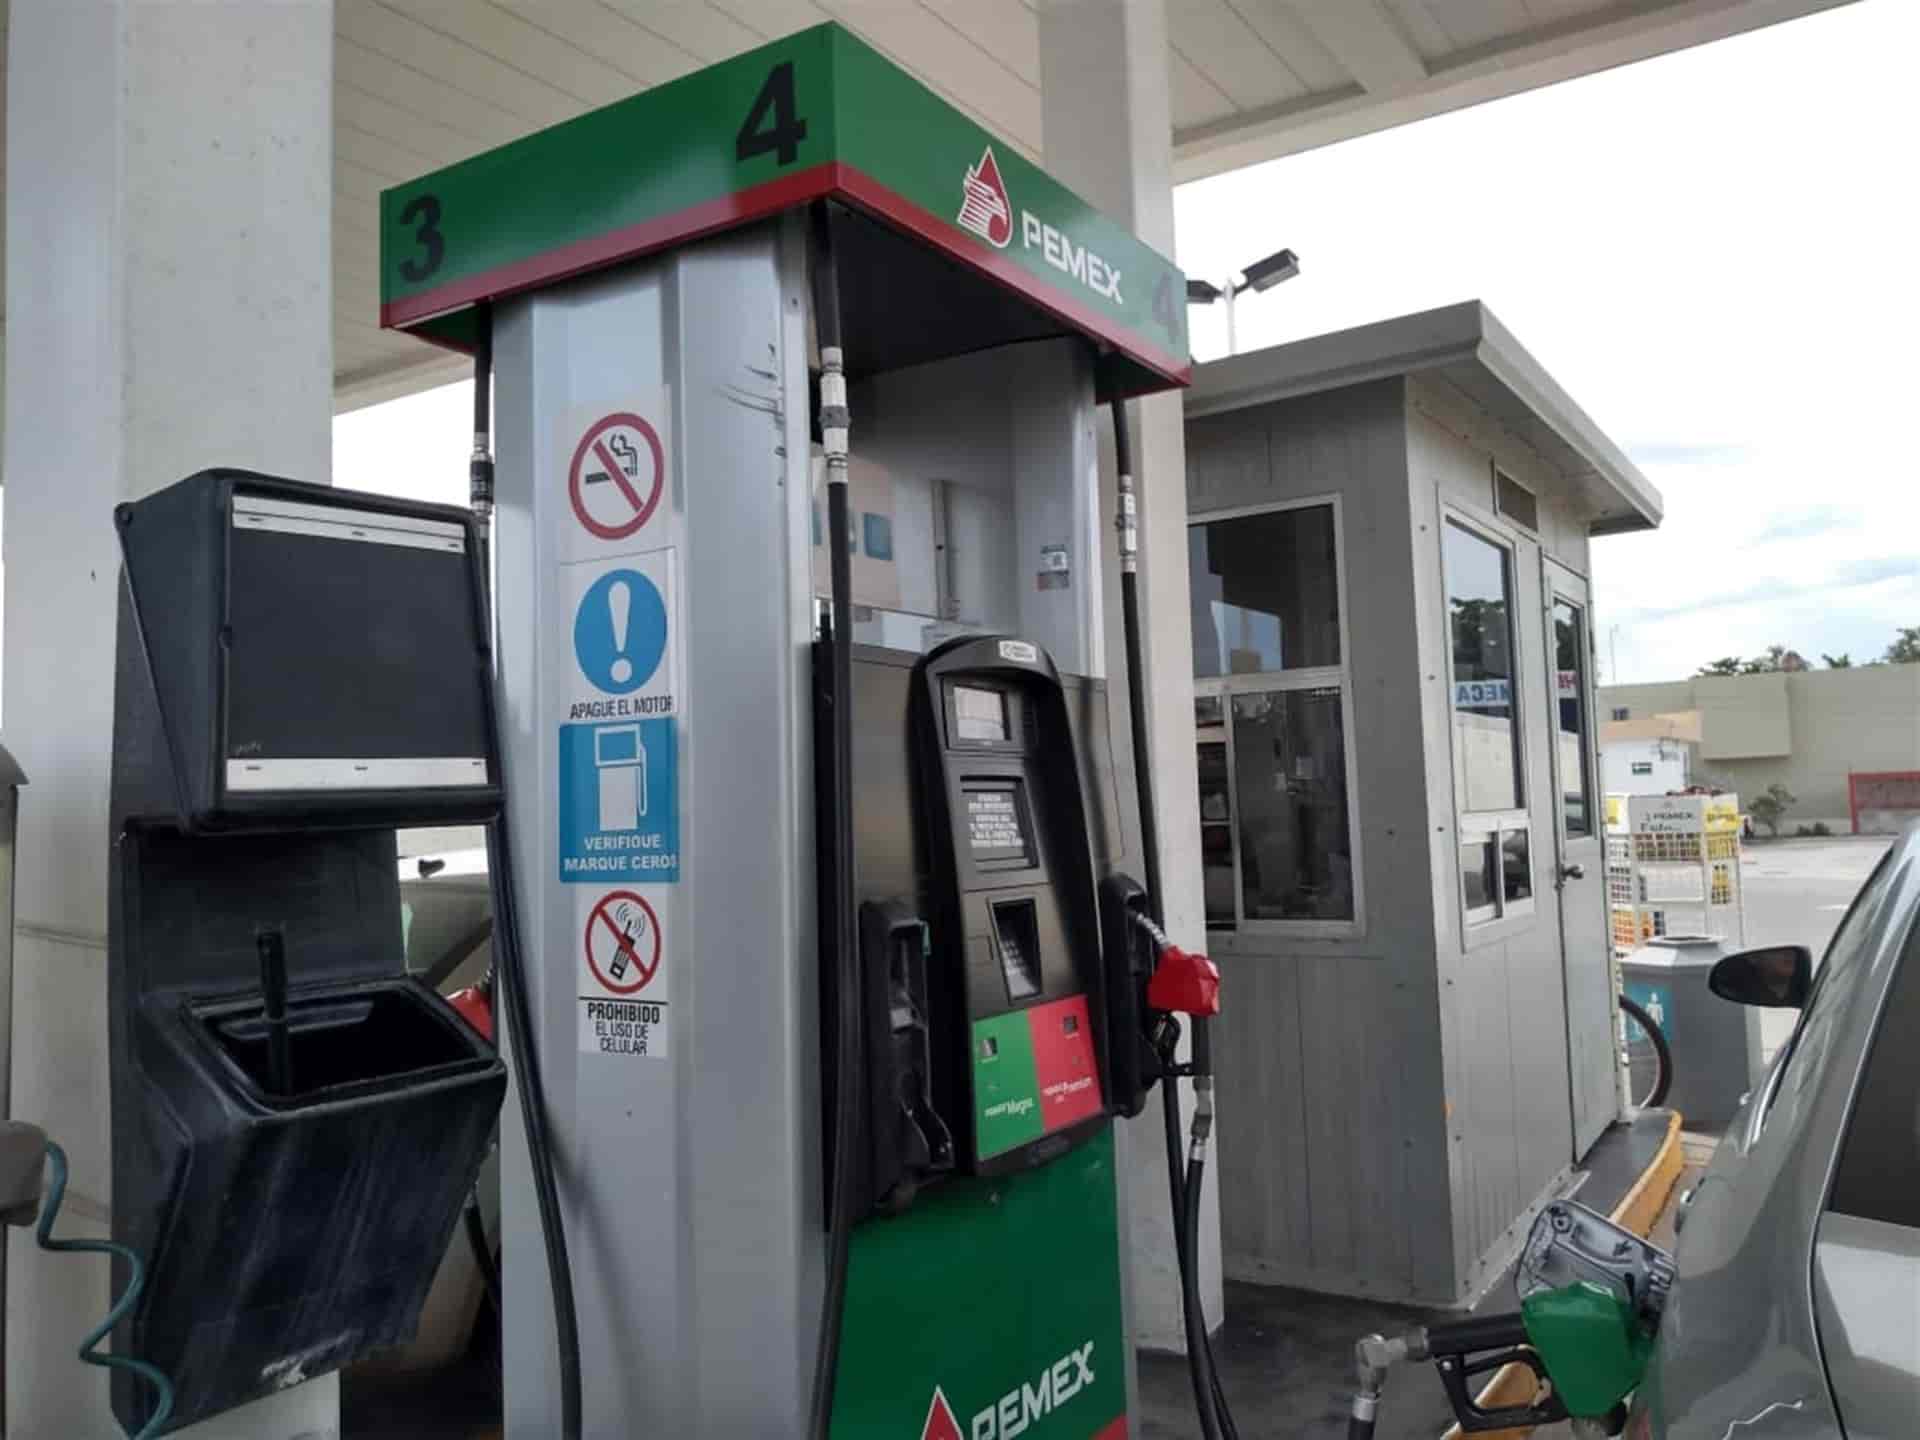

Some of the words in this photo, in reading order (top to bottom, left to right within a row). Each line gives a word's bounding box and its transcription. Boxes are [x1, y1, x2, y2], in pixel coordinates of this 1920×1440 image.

[736, 63, 806, 167] 4
[400, 196, 445, 282] 3
[1022, 209, 1123, 305] PEMEX
[1152, 272, 1178, 343] 4
[569, 699, 616, 719] APAGUE
[617, 699, 631, 715] EL
[583, 833, 661, 851] VERIFIQUE
[563, 855, 627, 872] MARQUE
[587, 1002, 660, 1024] PROHIBIDO
[595, 1021, 608, 1036] EL
[610, 1023, 632, 1038] USO
[634, 1023, 649, 1040] DE
[600, 1037, 647, 1056] CELULAR
[972, 1341, 1094, 1440] PEMEX
